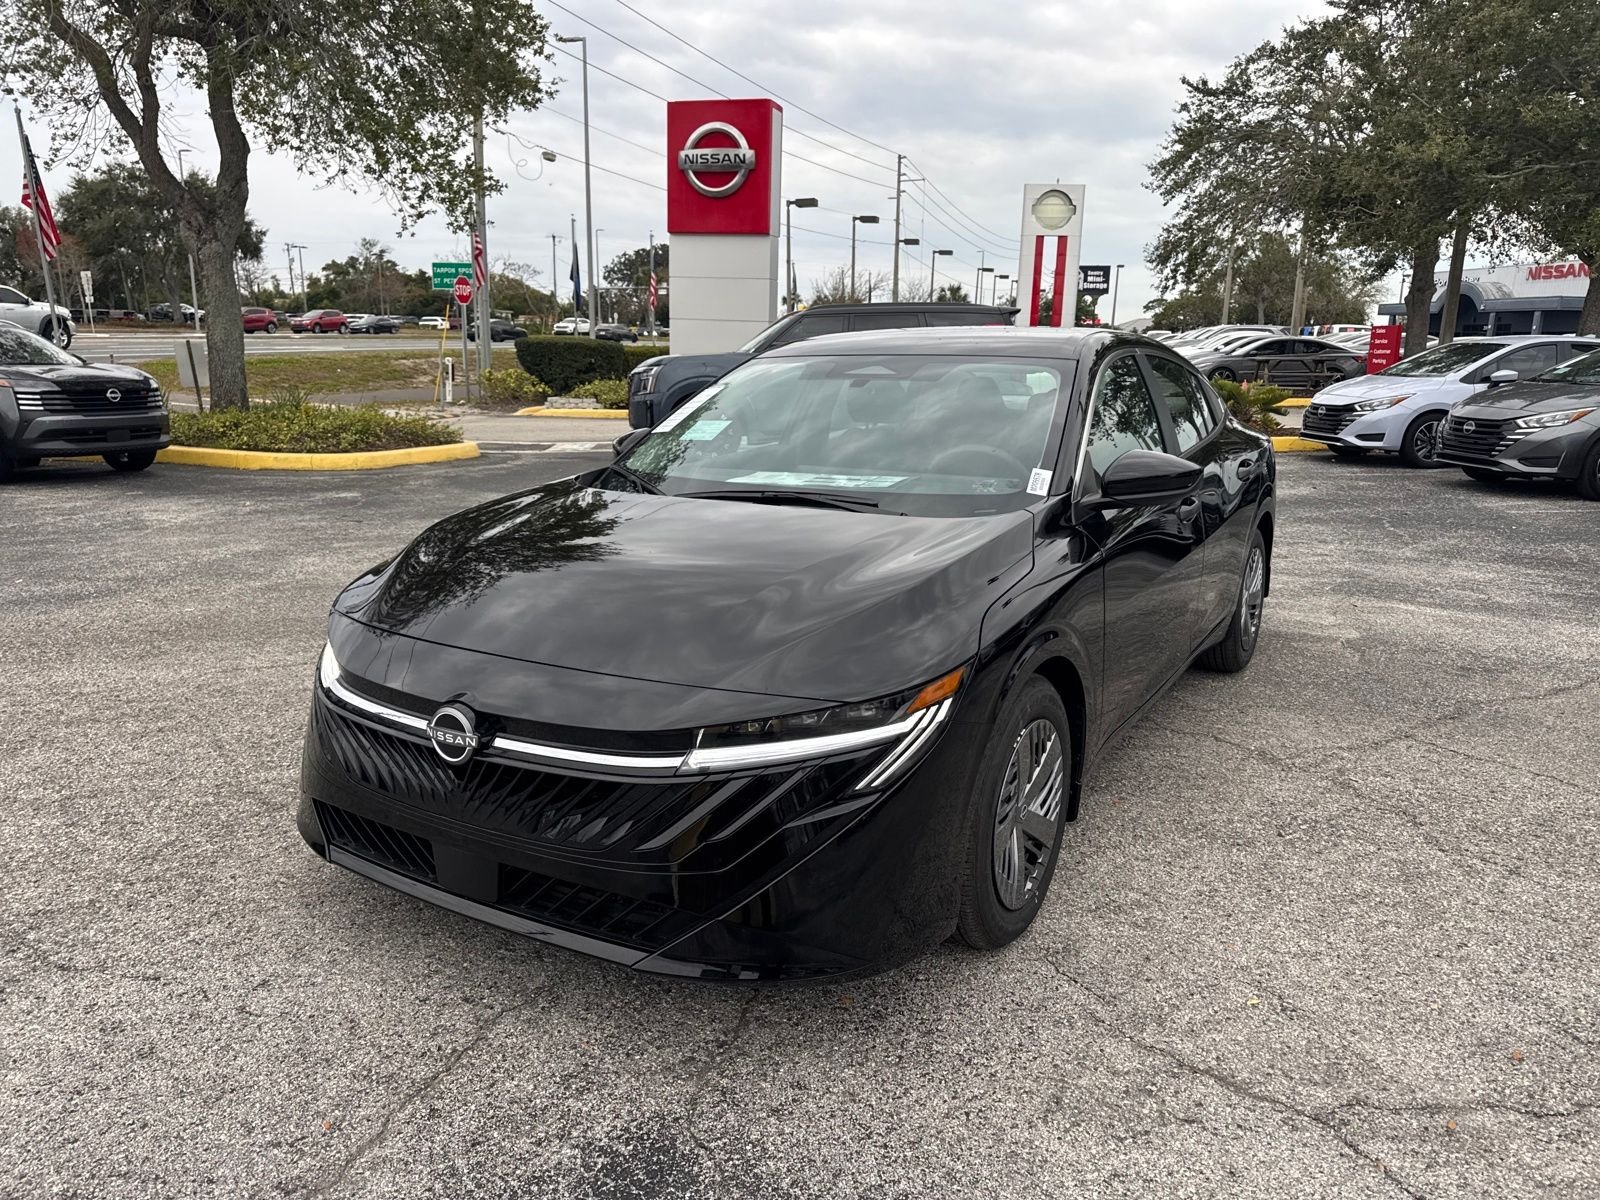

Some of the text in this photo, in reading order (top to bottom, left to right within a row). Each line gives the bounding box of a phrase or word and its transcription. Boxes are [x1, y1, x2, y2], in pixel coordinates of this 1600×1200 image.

[684, 153, 746, 165] NISSAN
[1526, 263, 1591, 281] NISSAN
[455, 284, 471, 296] STOP
[1083, 282, 1108, 290] Storage
[426, 726, 476, 747] NISSAN
